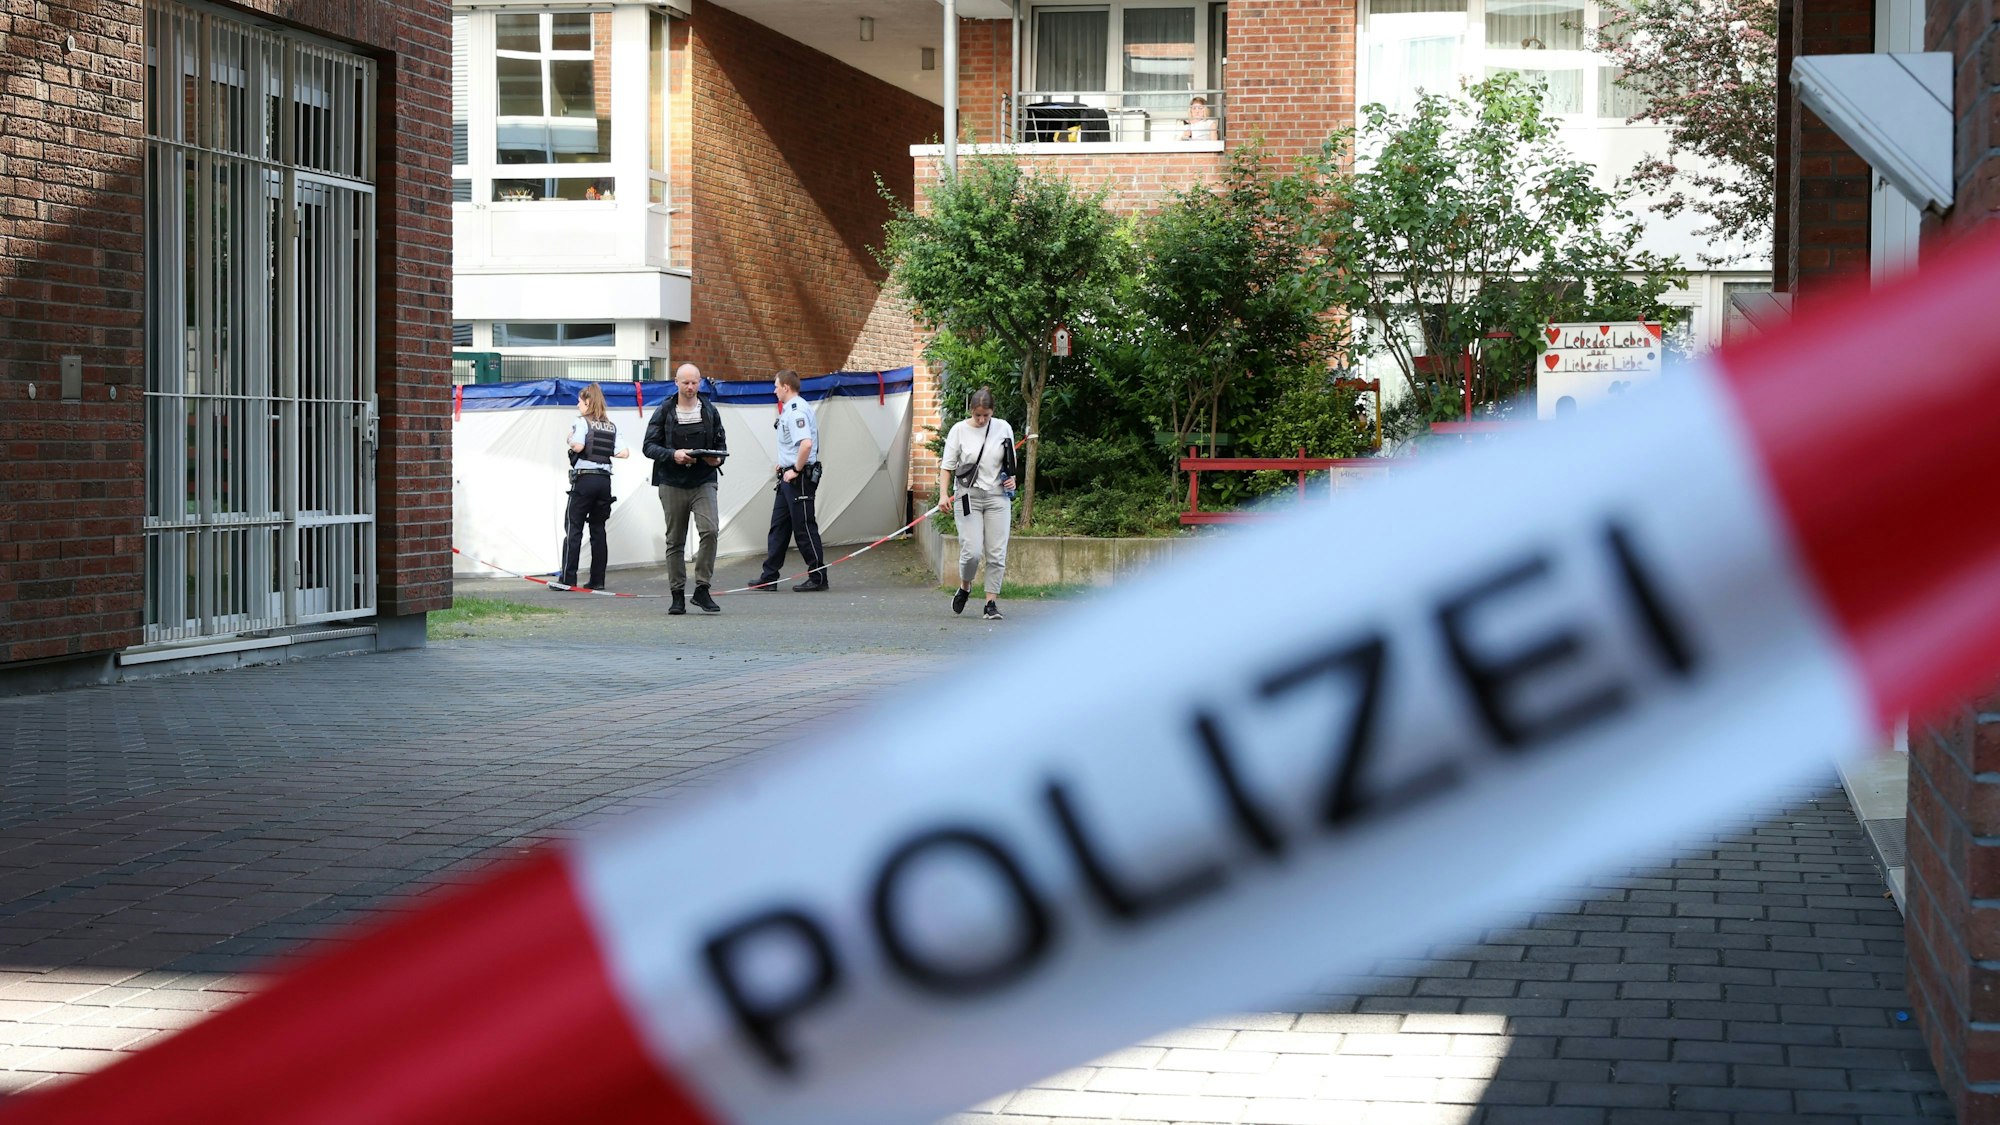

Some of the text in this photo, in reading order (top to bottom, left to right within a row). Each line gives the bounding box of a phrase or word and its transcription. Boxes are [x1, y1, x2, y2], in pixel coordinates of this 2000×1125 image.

[1564, 330, 1651, 348] Lebe das Leben
[1564, 355, 1643, 372] Liebe die Liebe
[591, 421, 615, 433] POLIZEI
[698, 520, 1702, 1072] POLIZEI
